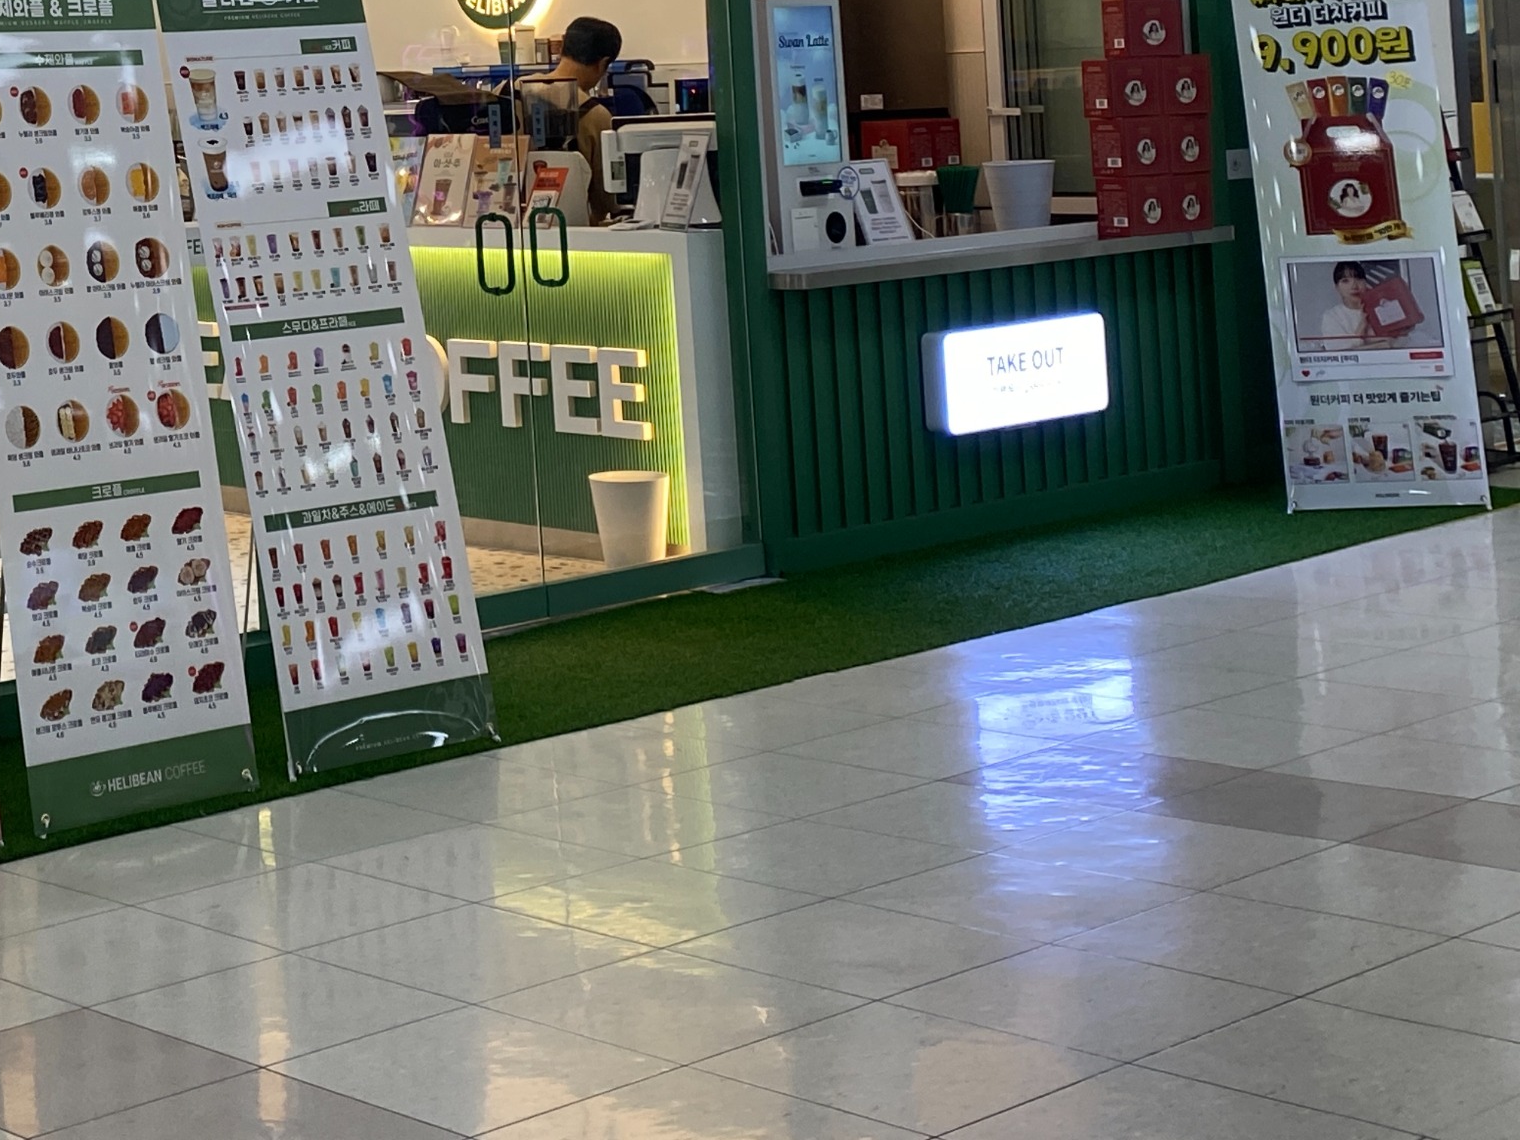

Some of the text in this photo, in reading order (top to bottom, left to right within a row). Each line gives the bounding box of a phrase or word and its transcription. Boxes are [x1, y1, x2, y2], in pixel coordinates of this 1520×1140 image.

[50, 0, 63, 17] &
[1271, 0, 1388, 28] 원더 더치커피
[332, 39, 351, 50] 커피
[779, 34, 829, 48] Swan Latte
[987, 347, 1064, 376] TAKE OUT
[1310, 393, 1351, 406] 원더커피
[1353, 393, 1364, 404] 더
[1366, 392, 1397, 404] 맛있게
[92, 483, 122, 499] 크로플
[107, 760, 206, 792] HELIBEAN COFFEE
